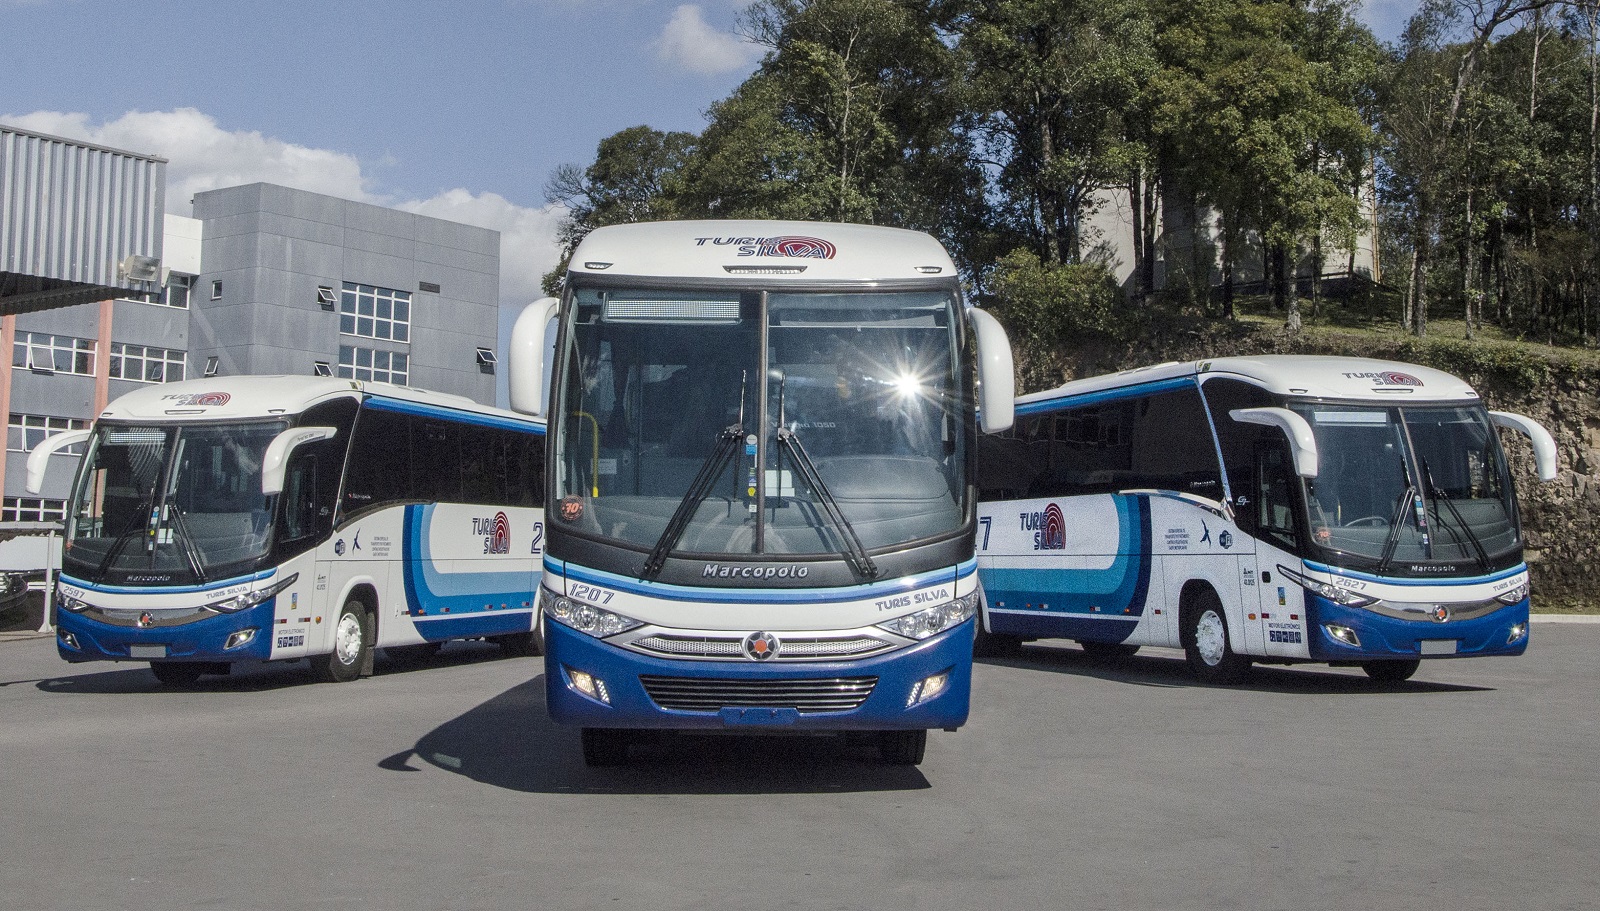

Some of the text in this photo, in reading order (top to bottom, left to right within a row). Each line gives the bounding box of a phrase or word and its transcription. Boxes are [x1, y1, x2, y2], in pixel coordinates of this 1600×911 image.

[694, 236, 782, 246] TURIS
[736, 246, 826, 260] SILVA
[472, 517, 498, 536] TURIS
[1019, 511, 1048, 531] TURIS
[975, 516, 992, 551] 7
[1034, 531, 1063, 551] SILVA
[483, 537, 508, 555] SILVA
[702, 563, 809, 580] Marcopolo
[1411, 564, 1456, 573] Marcopolo
[126, 574, 171, 582] Marcopolo
[1335, 577, 1367, 590] 2627
[1492, 576, 1523, 592] TURIS SILVA
[63, 585, 86, 599] 2597
[206, 585, 248, 600] TURIS SILVA
[569, 583, 615, 605] 1207
[874, 588, 950, 612] TURIS SILVA
